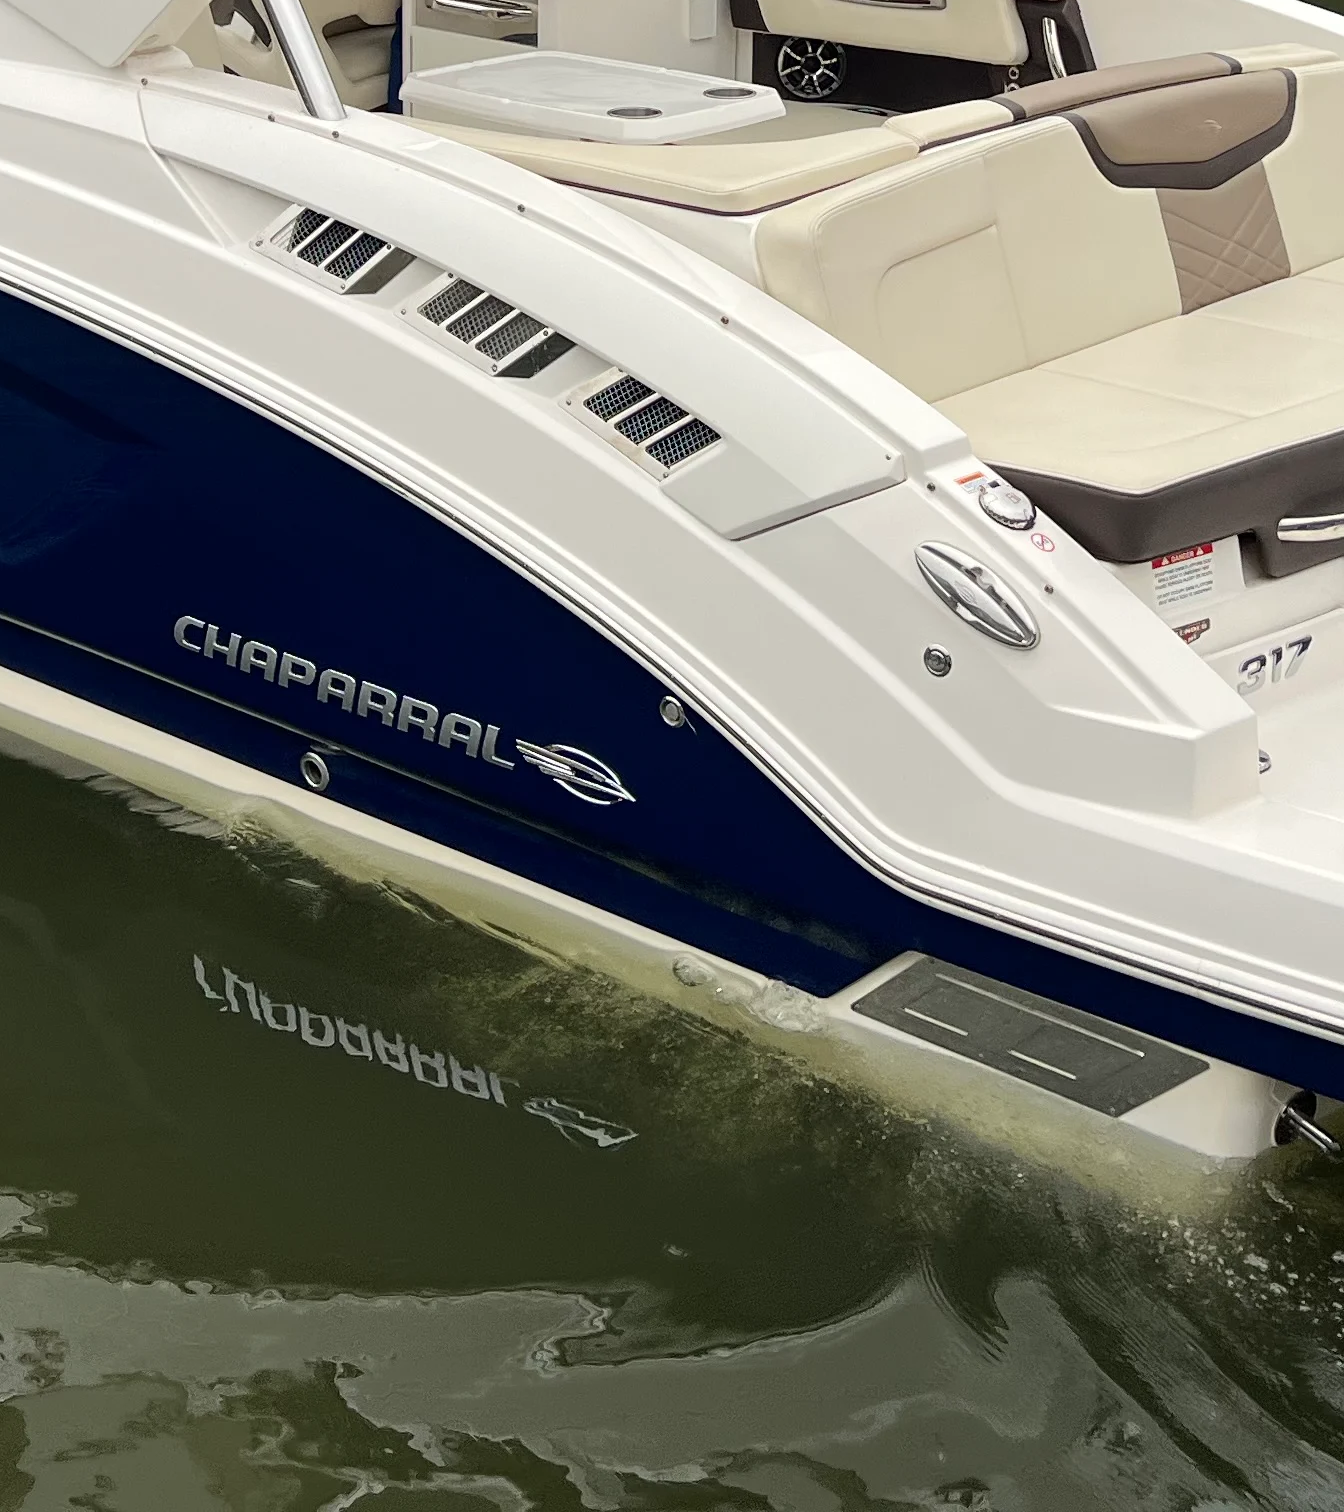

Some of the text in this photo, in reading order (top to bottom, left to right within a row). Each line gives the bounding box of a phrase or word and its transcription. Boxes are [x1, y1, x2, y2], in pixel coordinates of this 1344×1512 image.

[1170, 550, 1196, 564] DANGER
[173, 615, 516, 771] CHAPARRAL
[1237, 634, 1313, 696] 317
